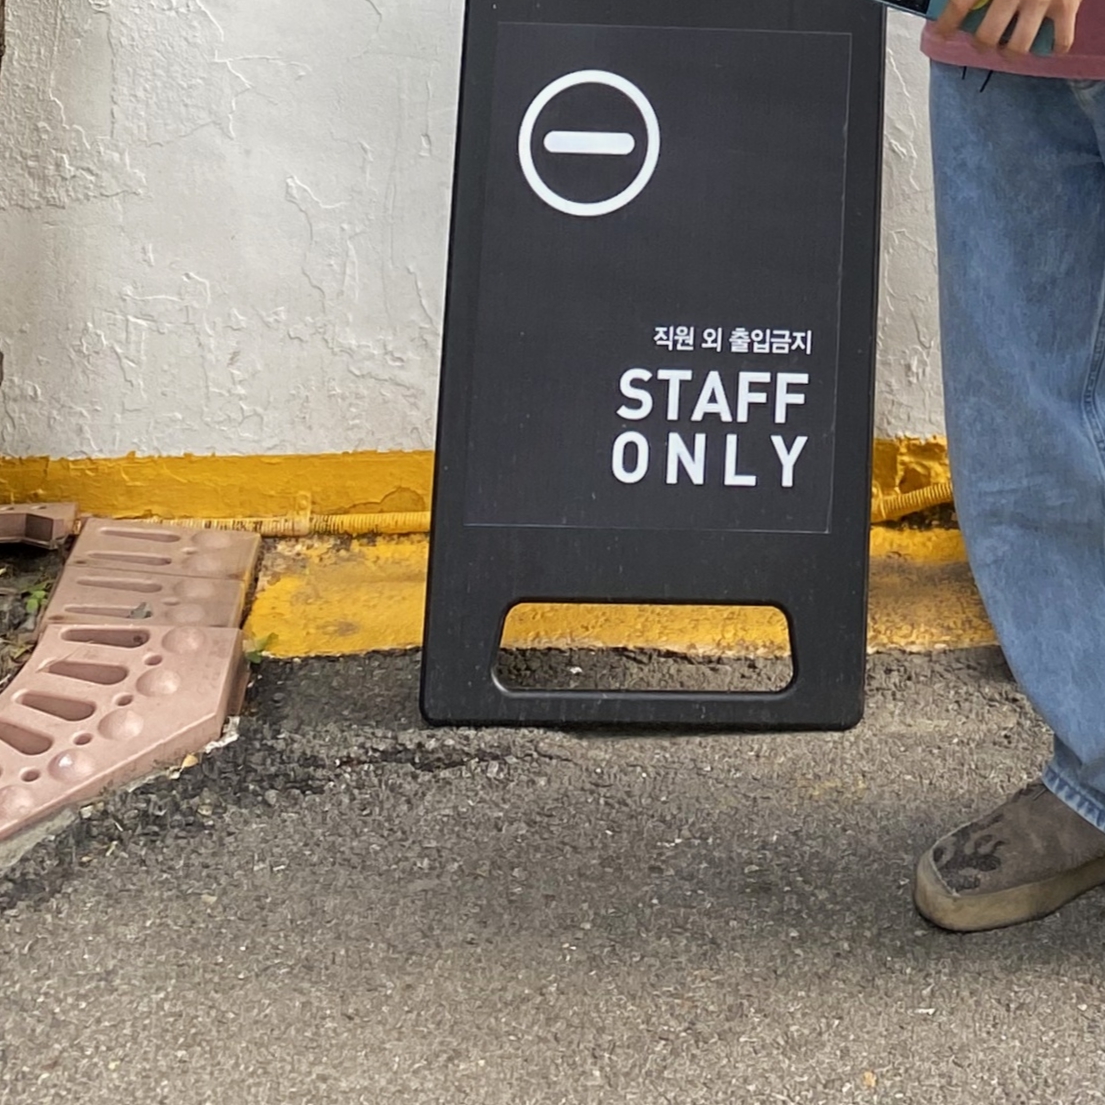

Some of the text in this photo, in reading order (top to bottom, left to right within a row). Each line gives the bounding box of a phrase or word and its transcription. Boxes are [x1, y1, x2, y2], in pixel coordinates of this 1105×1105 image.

[653, 325, 813, 355] 직원 외 출입금지
[616, 367, 810, 424] STAFF
[611, 430, 809, 488] ONLY
